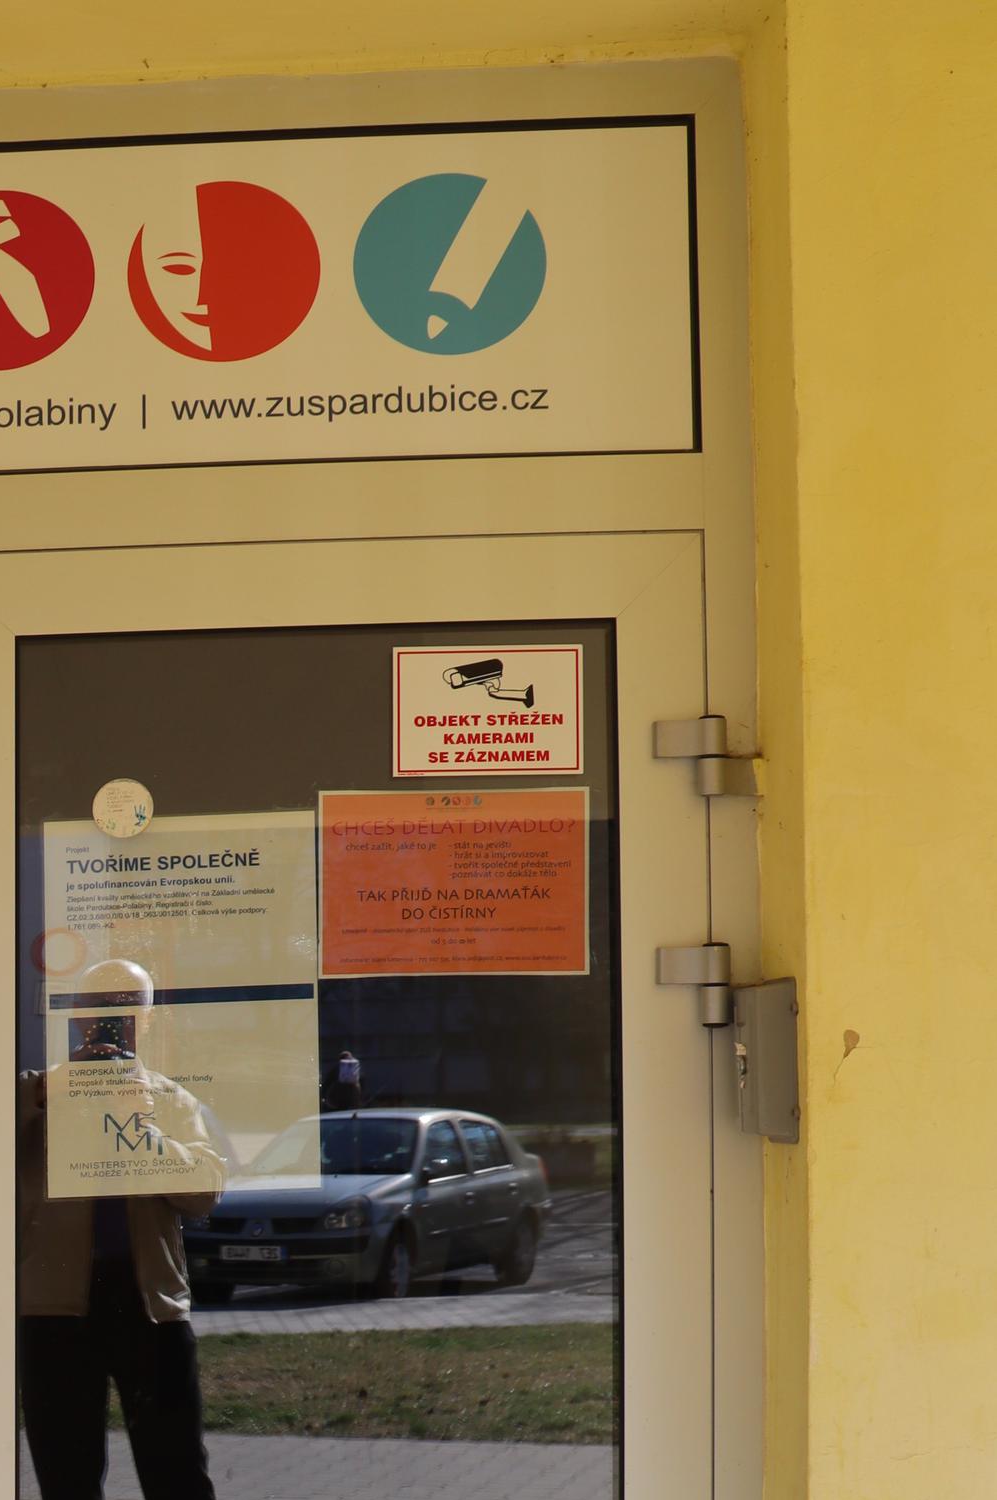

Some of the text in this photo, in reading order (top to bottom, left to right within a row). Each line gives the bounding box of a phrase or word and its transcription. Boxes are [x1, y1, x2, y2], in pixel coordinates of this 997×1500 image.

[170, 384, 549, 424] www.zuspardubice.cz
[413, 711, 564, 727] OBJEKT STŘEŽEN
[443, 732, 534, 745] KAMERAMI
[428, 748, 550, 764] SE ZÁZNAMEM
[331, 816, 576, 836] CHCEŠ DĚLAT DIVADLO?
[65, 848, 261, 875] TVOŘÍME SPOLEČNĚ
[65, 875, 235, 893] je spolufinancován Evropskou unii.
[357, 886, 551, 902] TAK PŘIJĎ NA DRAMAŤÁK
[401, 904, 496, 920] DO ČISTÍRNY
[68, 1067, 137, 1077] EVROPSKÁ UNIE
[191, 1074, 214, 1083] fondy
[68, 1090, 81, 1098] OP
[69, 1159, 148, 1171] MINISTERSTVO
